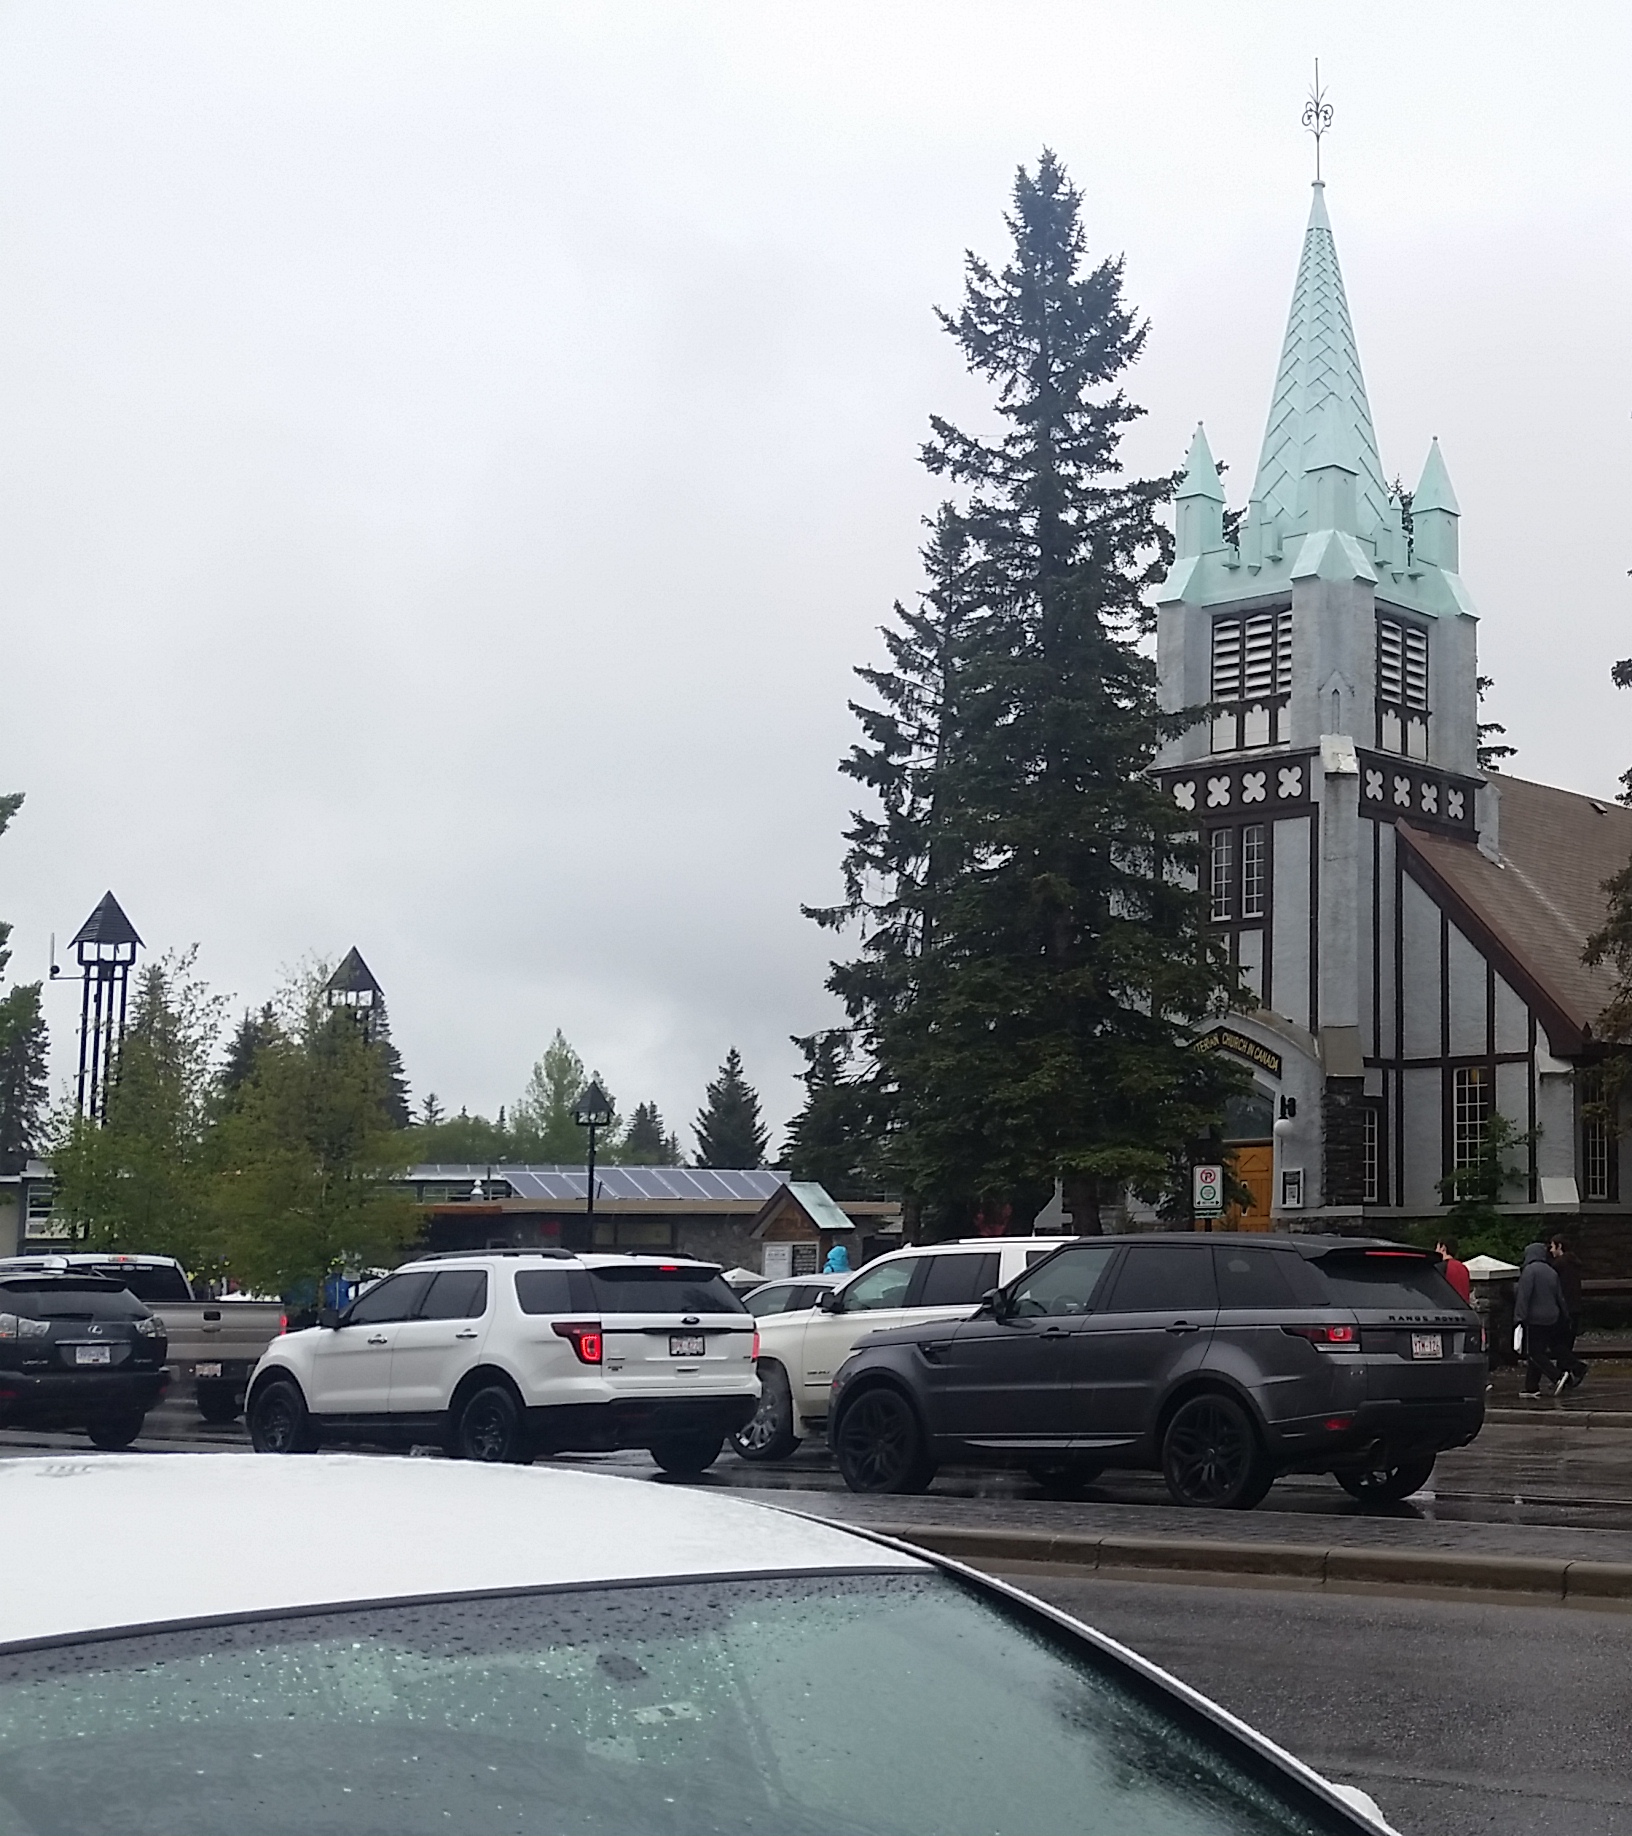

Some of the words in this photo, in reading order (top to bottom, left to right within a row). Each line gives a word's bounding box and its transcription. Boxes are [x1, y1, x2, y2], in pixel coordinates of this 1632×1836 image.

[1222, 1032, 1247, 1053] CHURCH
[1246, 1042, 1255, 1056] IN
[1254, 1047, 1279, 1071] CANADA
